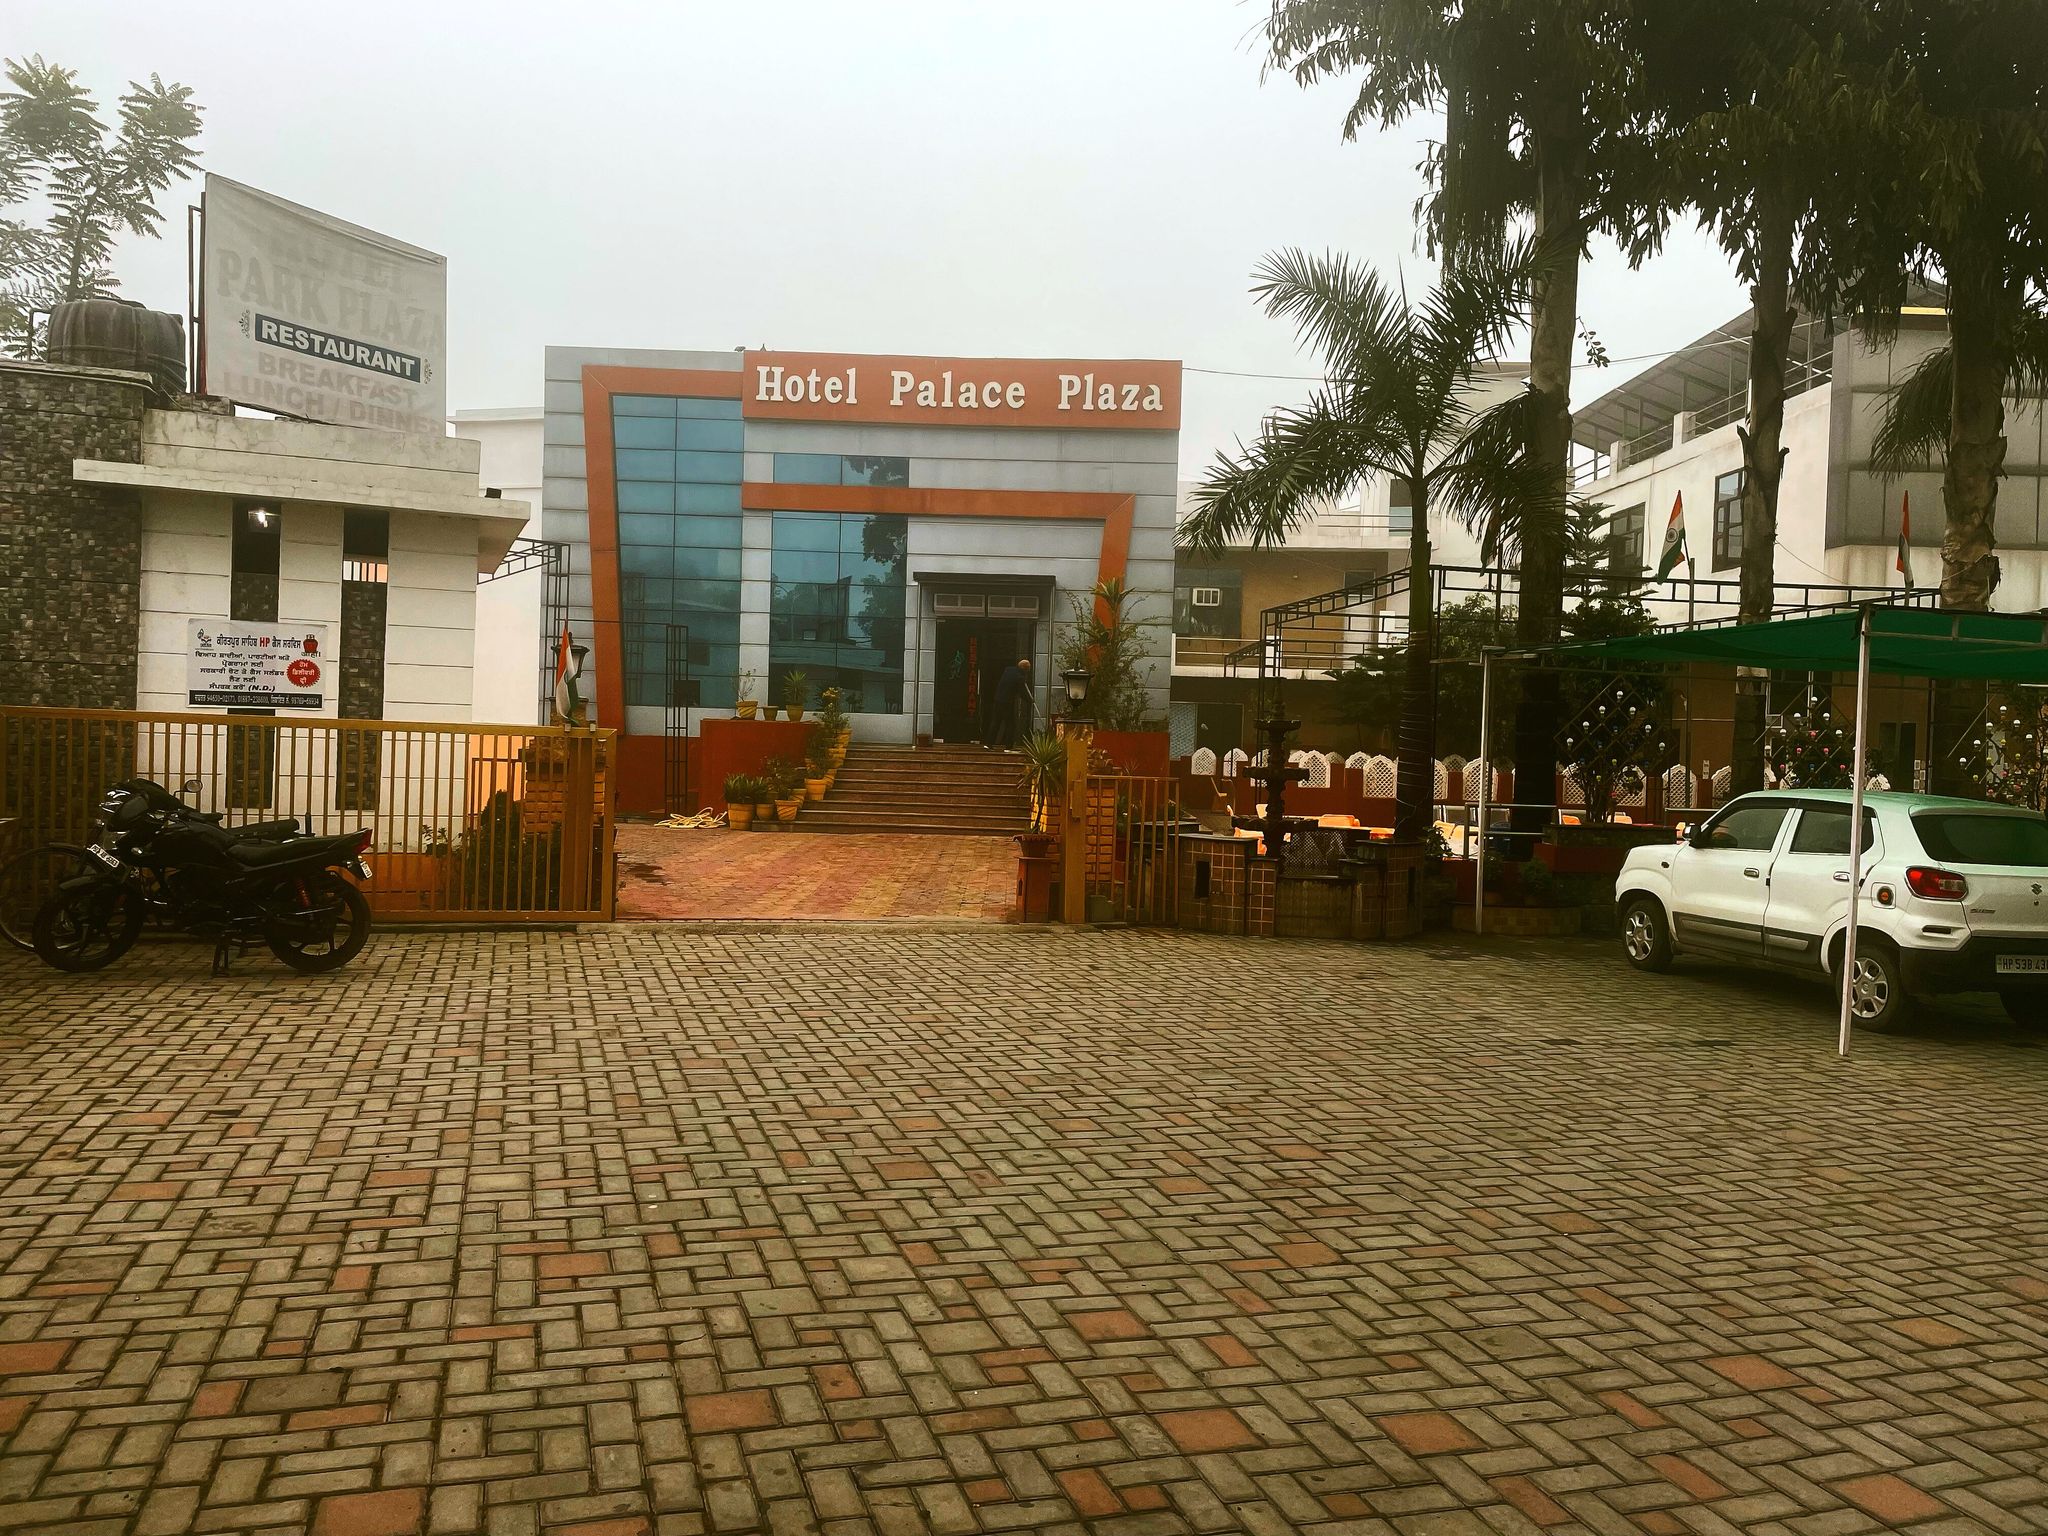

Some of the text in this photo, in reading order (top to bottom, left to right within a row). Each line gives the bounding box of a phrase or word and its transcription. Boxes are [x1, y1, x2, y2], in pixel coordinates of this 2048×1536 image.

[216, 248, 328, 324] PARK
[260, 319, 416, 377] RESTAURANT
[223, 372, 324, 418] LUNCH
[258, 352, 419, 406] BREAKFAST
[755, 365, 1164, 412] Hotel Palace Plaza
[259, 636, 270, 647] HP
